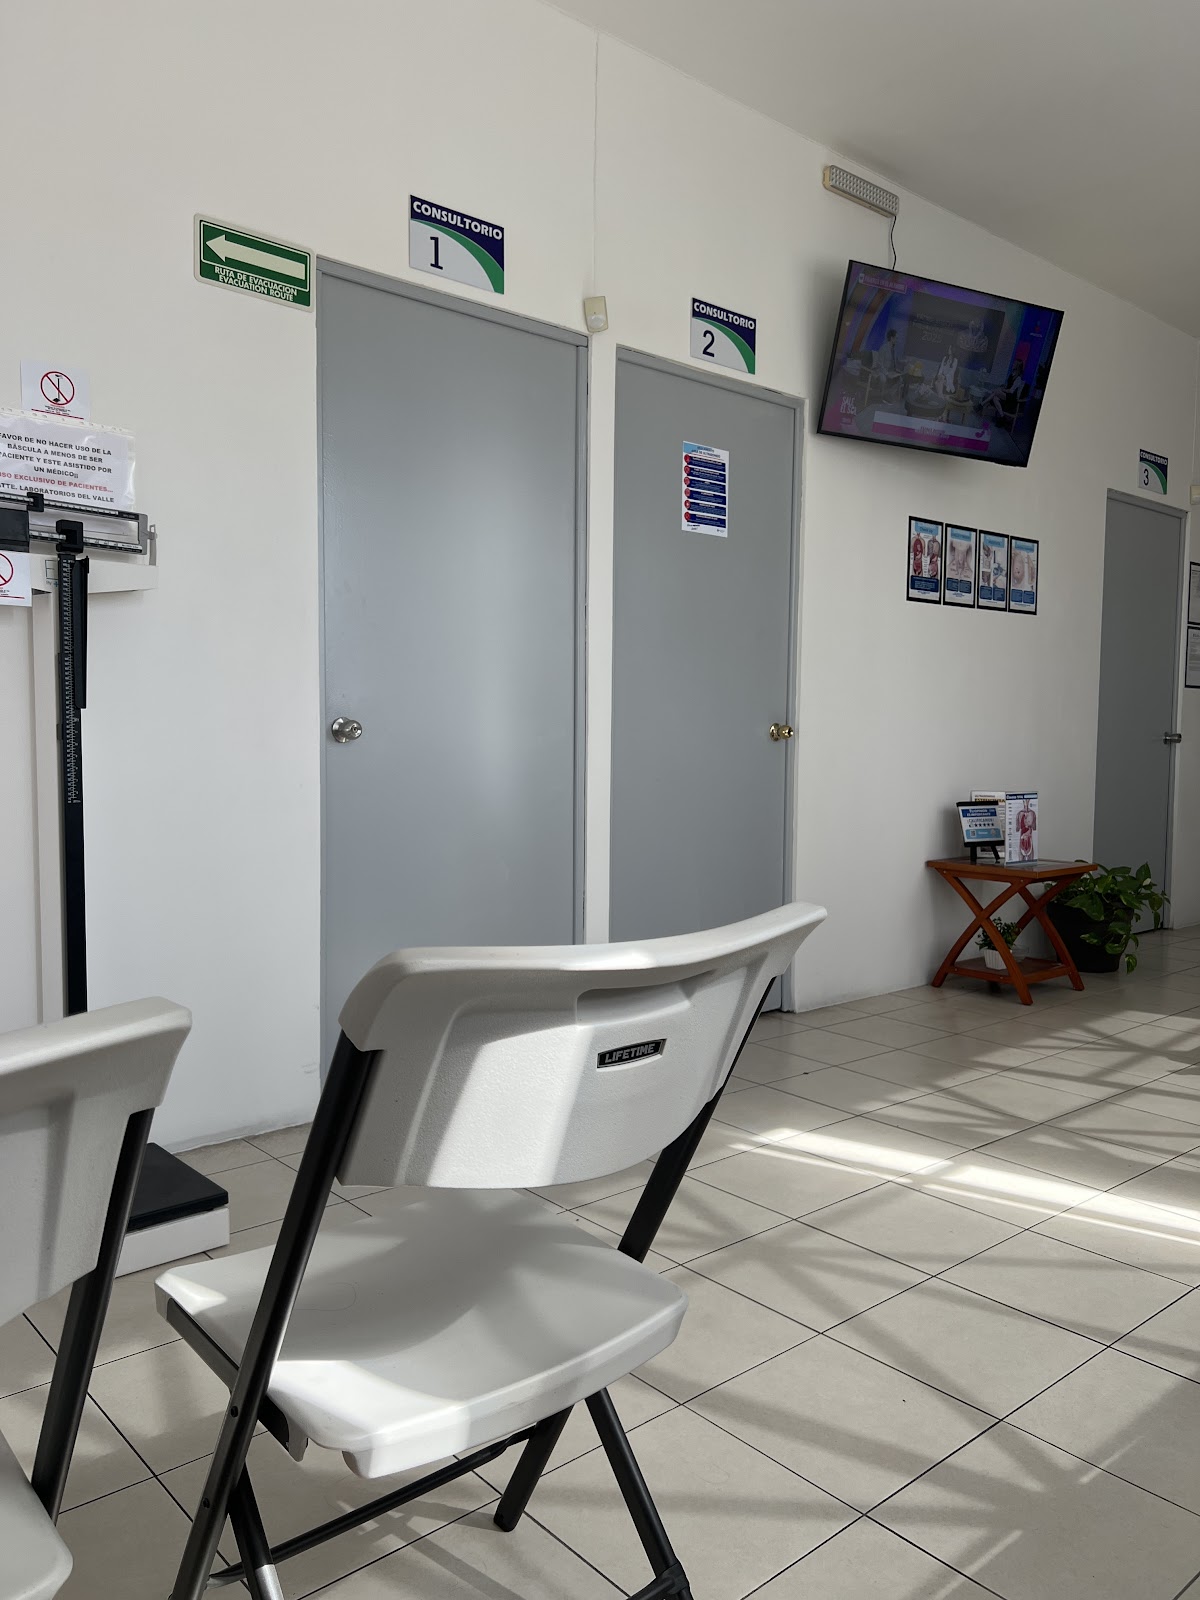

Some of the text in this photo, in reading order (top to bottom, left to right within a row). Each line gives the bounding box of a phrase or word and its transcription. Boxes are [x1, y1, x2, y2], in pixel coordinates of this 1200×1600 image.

[413, 201, 502, 240] CONSULTORIO
[430, 236, 443, 270] 1
[214, 266, 297, 296] RUTA DE EVACUACION
[219, 275, 294, 301] EVACUATION ROUTE
[693, 302, 755, 329] CONSULTORIO
[702, 329, 715, 357] 2
[49, 441, 73, 449] HACER
[51, 450, 76, 459] MENOS
[43, 458, 61, 466] ESTE
[63, 461, 96, 471] ASISTIDO
[14, 473, 56, 484] EXCLUSIVO
[1143, 468, 1149, 486] 3
[0, 482, 17, 490] TTE.
[20, 485, 76, 498] LABORATORIOS
[92, 495, 114, 503] VALLE
[604, 1043, 656, 1064] LIFETIME
